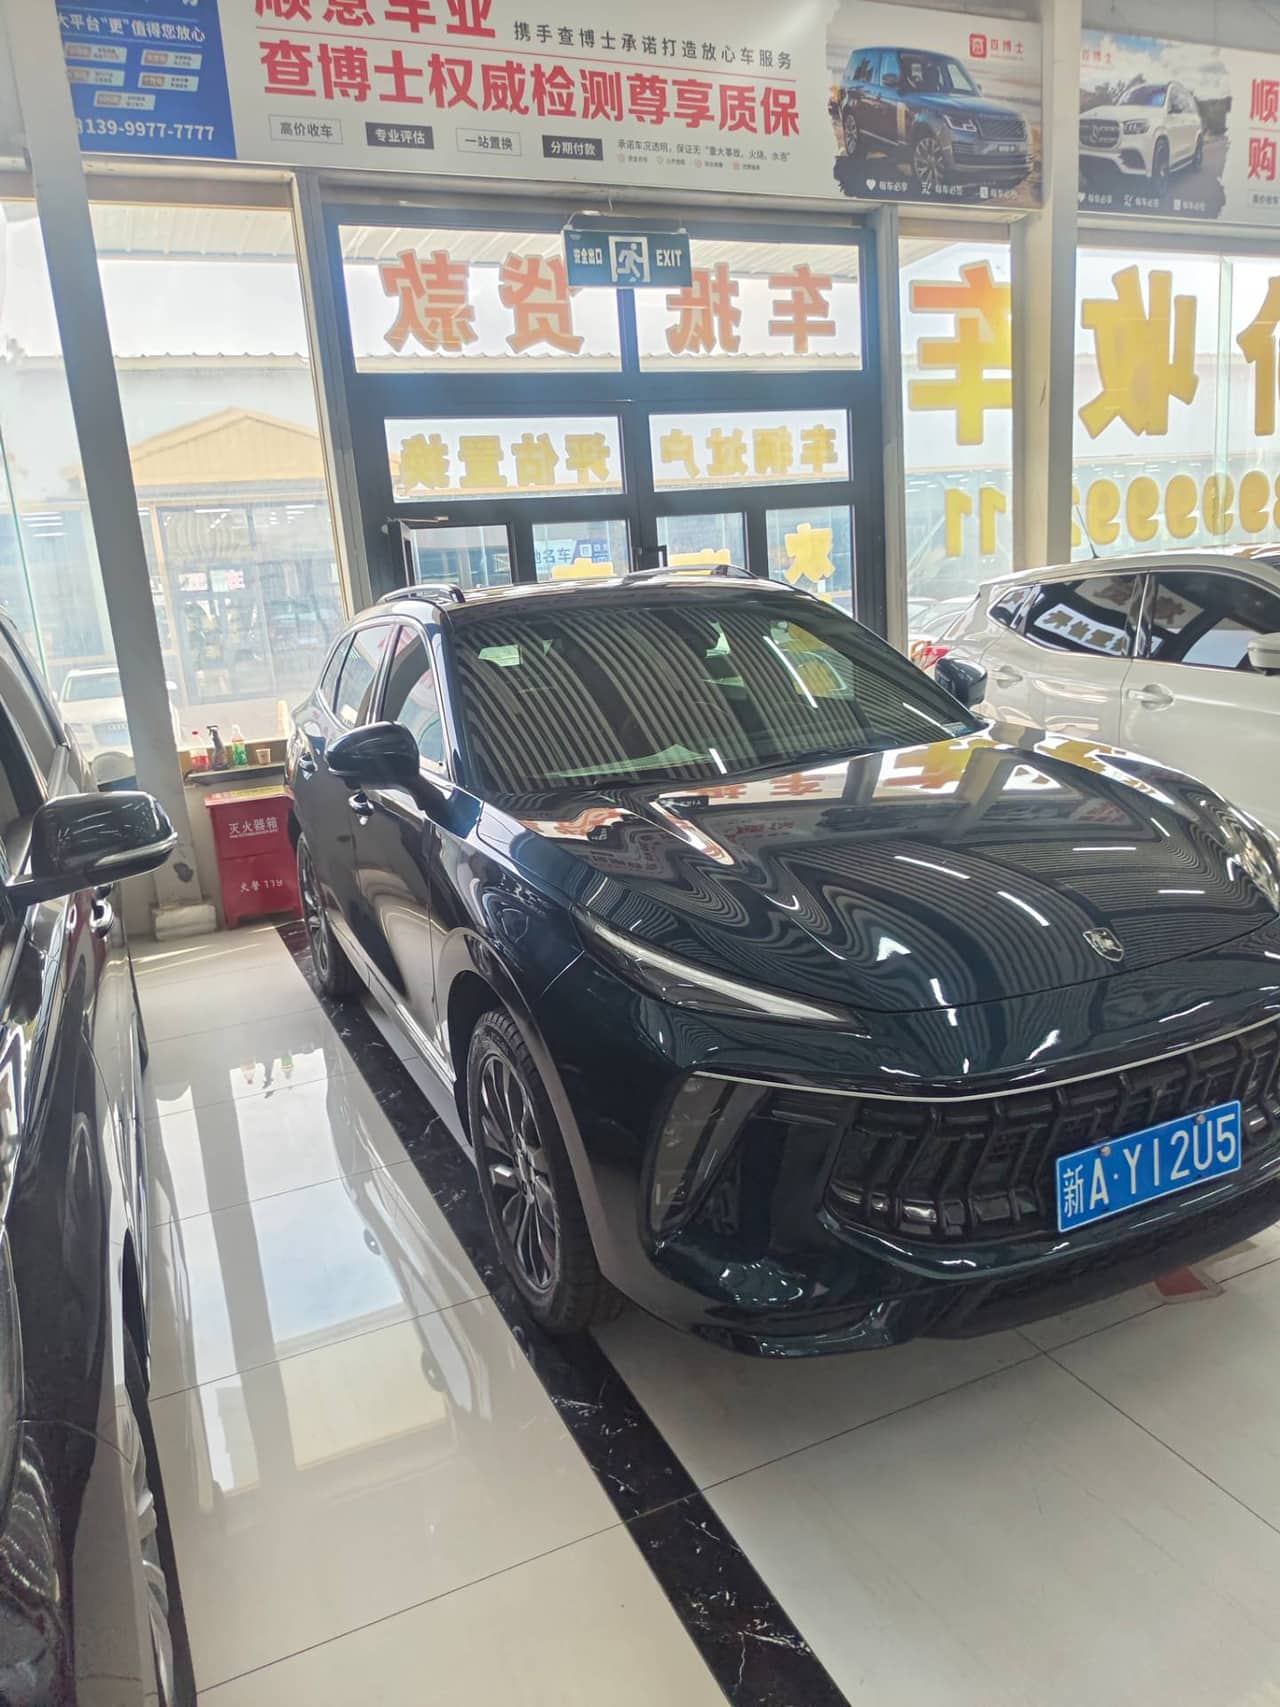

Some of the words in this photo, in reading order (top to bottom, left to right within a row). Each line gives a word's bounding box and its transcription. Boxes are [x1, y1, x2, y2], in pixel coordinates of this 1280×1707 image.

[513, 21, 793, 70] 携手查博士承诺打造放心车服务
[259, 40, 799, 136] 查博士权威检测尊享质保
[279, 120, 334, 139] 高价收车
[374, 128, 426, 145] 专业评估
[464, 134, 513, 151] 一站置换
[550, 140, 597, 157] 分期付款
[573, 247, 603, 265] 安全出口
[656, 248, 682, 267] EXIT
[1062, 1113, 1236, 1219] 新A·Y12U5
